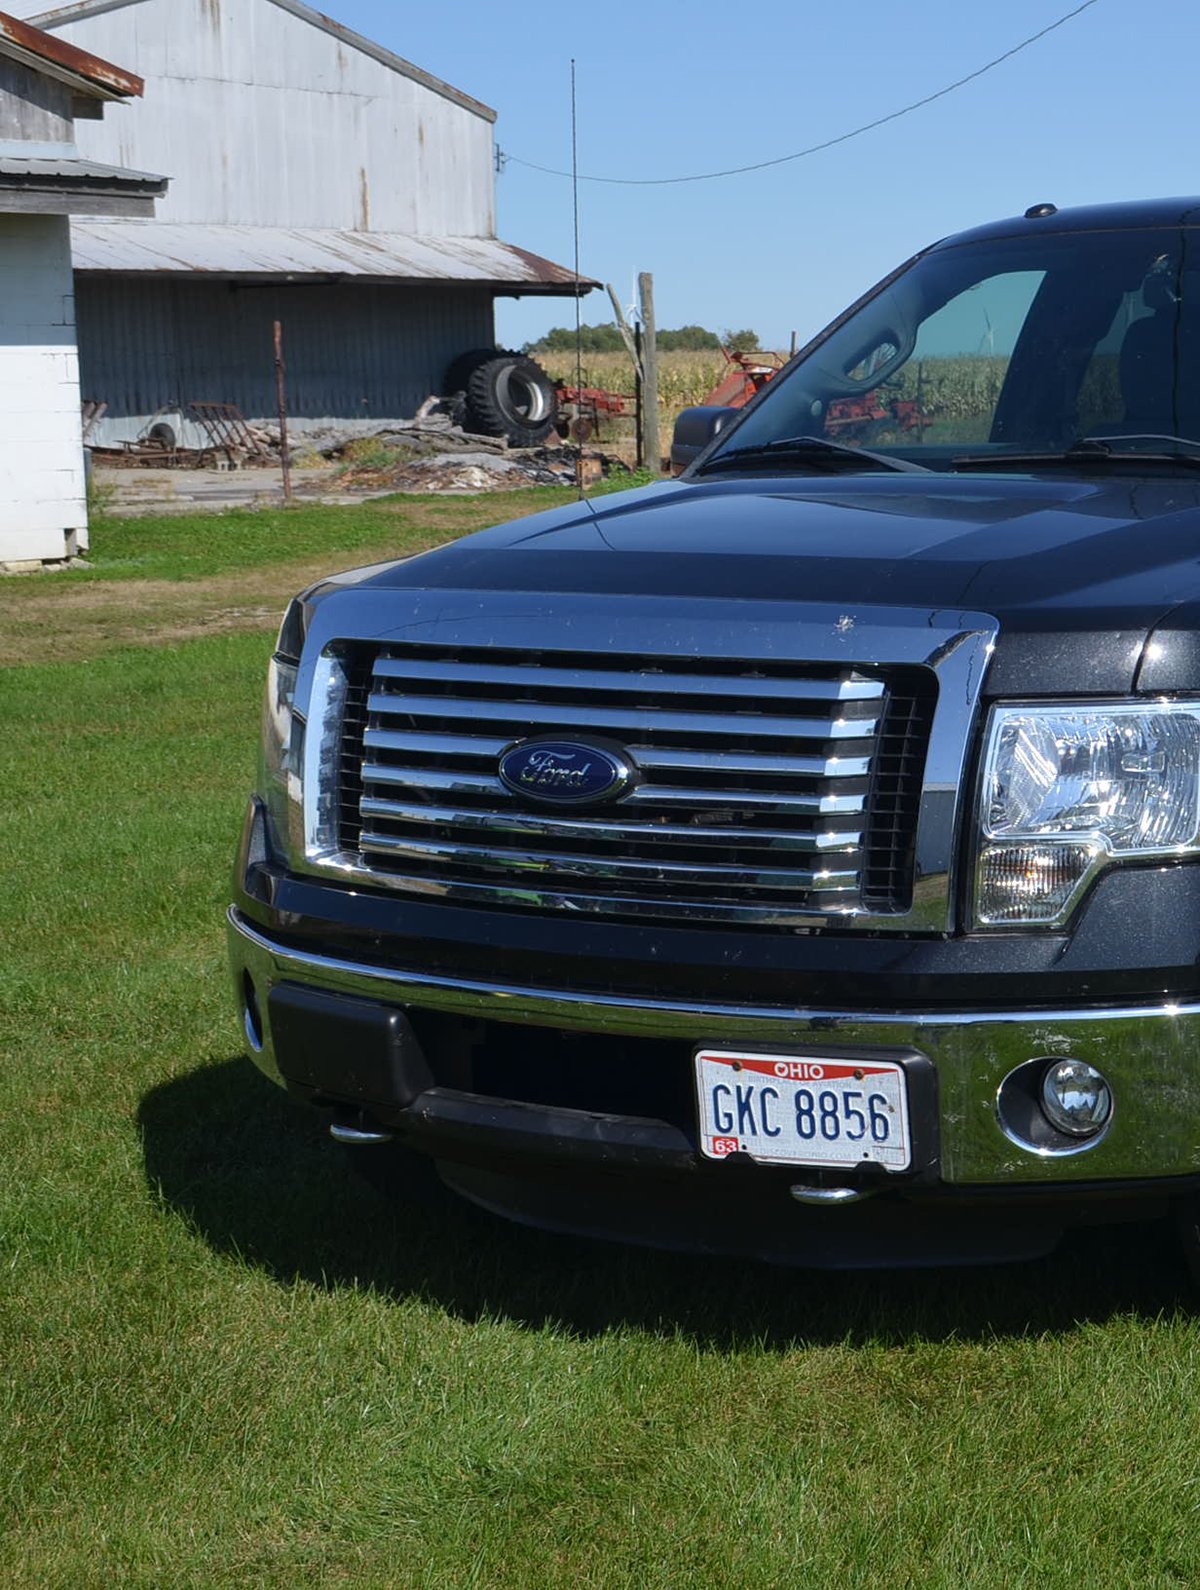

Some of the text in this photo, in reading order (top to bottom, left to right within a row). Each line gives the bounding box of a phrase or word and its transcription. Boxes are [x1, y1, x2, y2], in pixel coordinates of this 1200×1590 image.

[520, 750, 592, 787] Ford
[774, 1062, 825, 1080] OHIO
[712, 1084, 890, 1142] GKC 8856
[715, 1140, 737, 1153] 63
